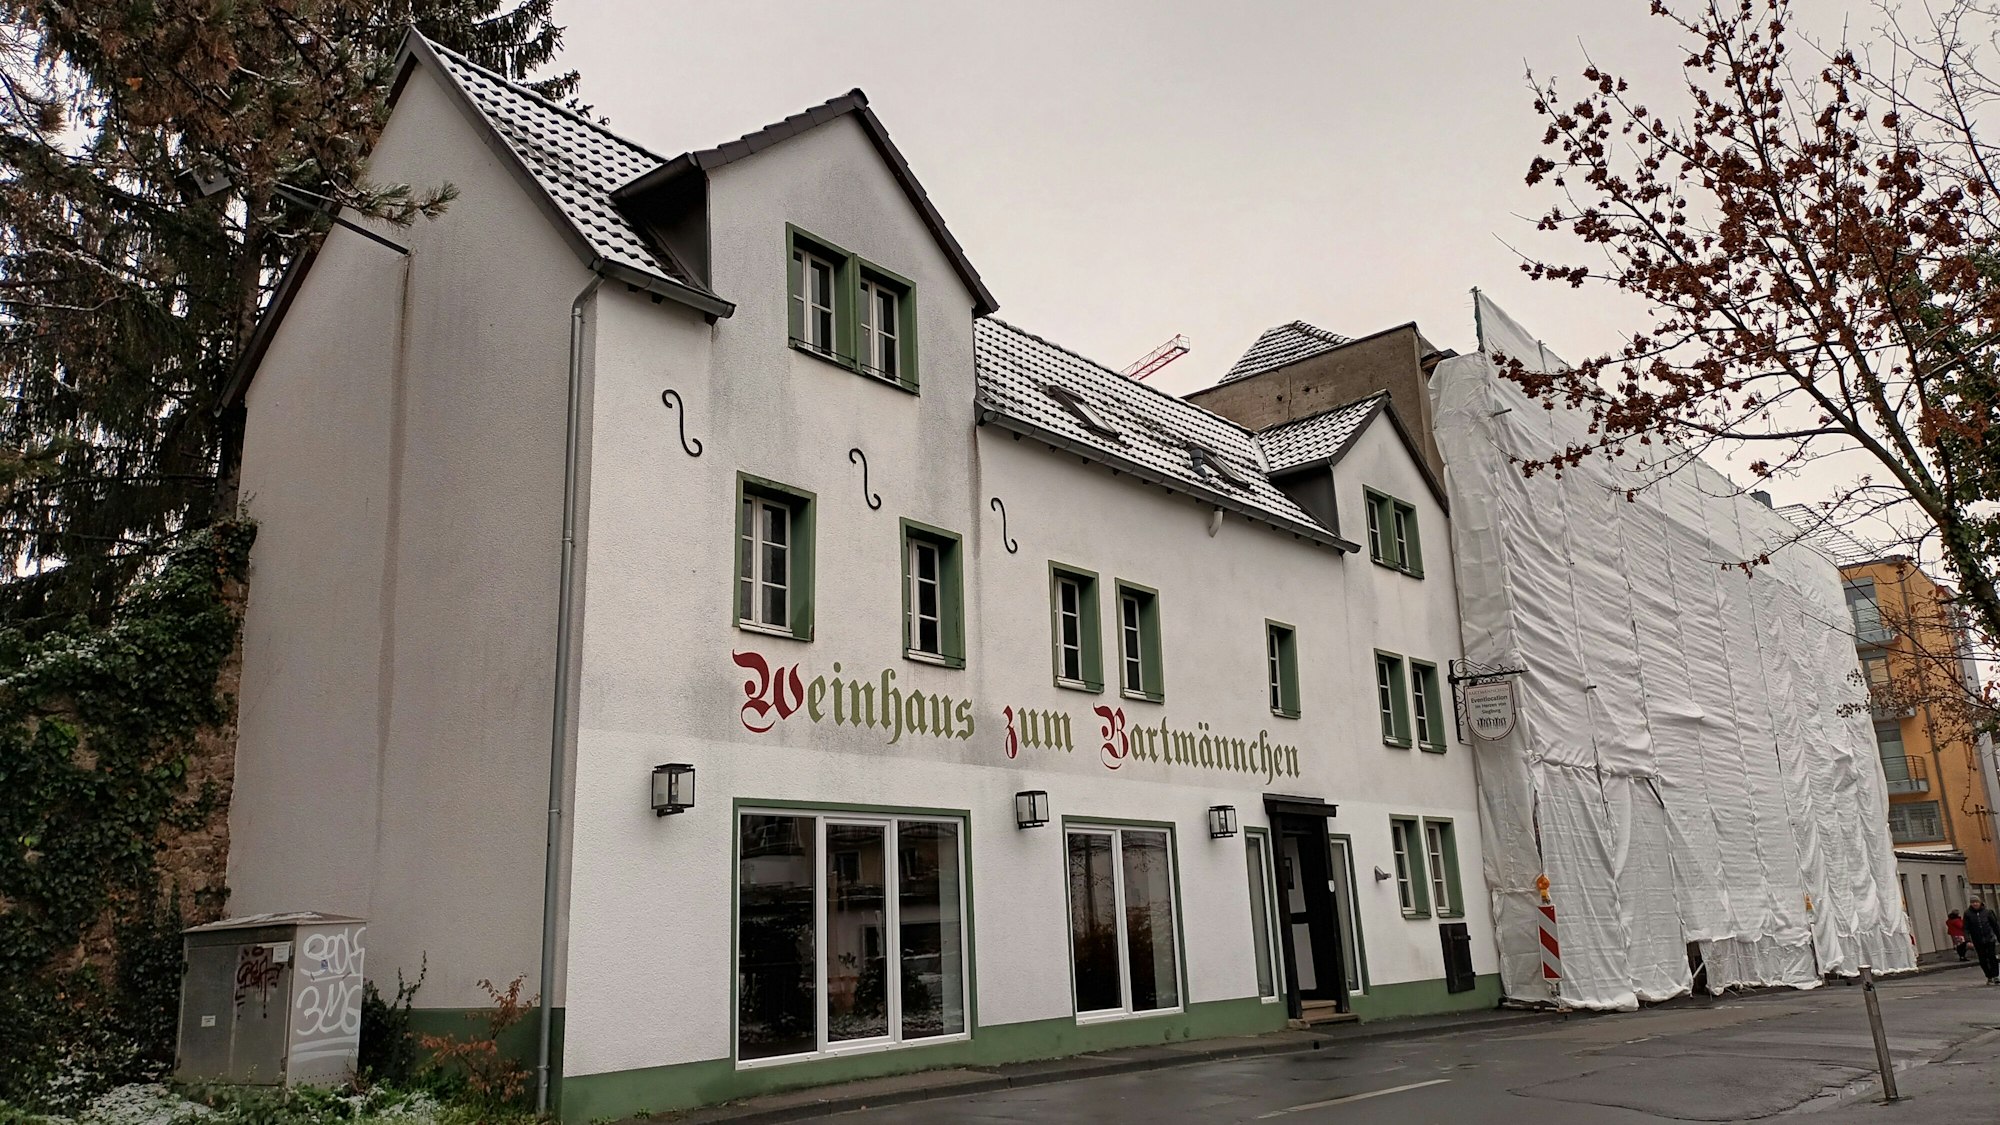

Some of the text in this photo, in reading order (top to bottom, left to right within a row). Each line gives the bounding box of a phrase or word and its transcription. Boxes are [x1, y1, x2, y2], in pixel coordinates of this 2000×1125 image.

[732, 648, 1300, 785] Weinhaus zum Bartmännchen
[1471, 695, 1507, 703] Eventlocation
